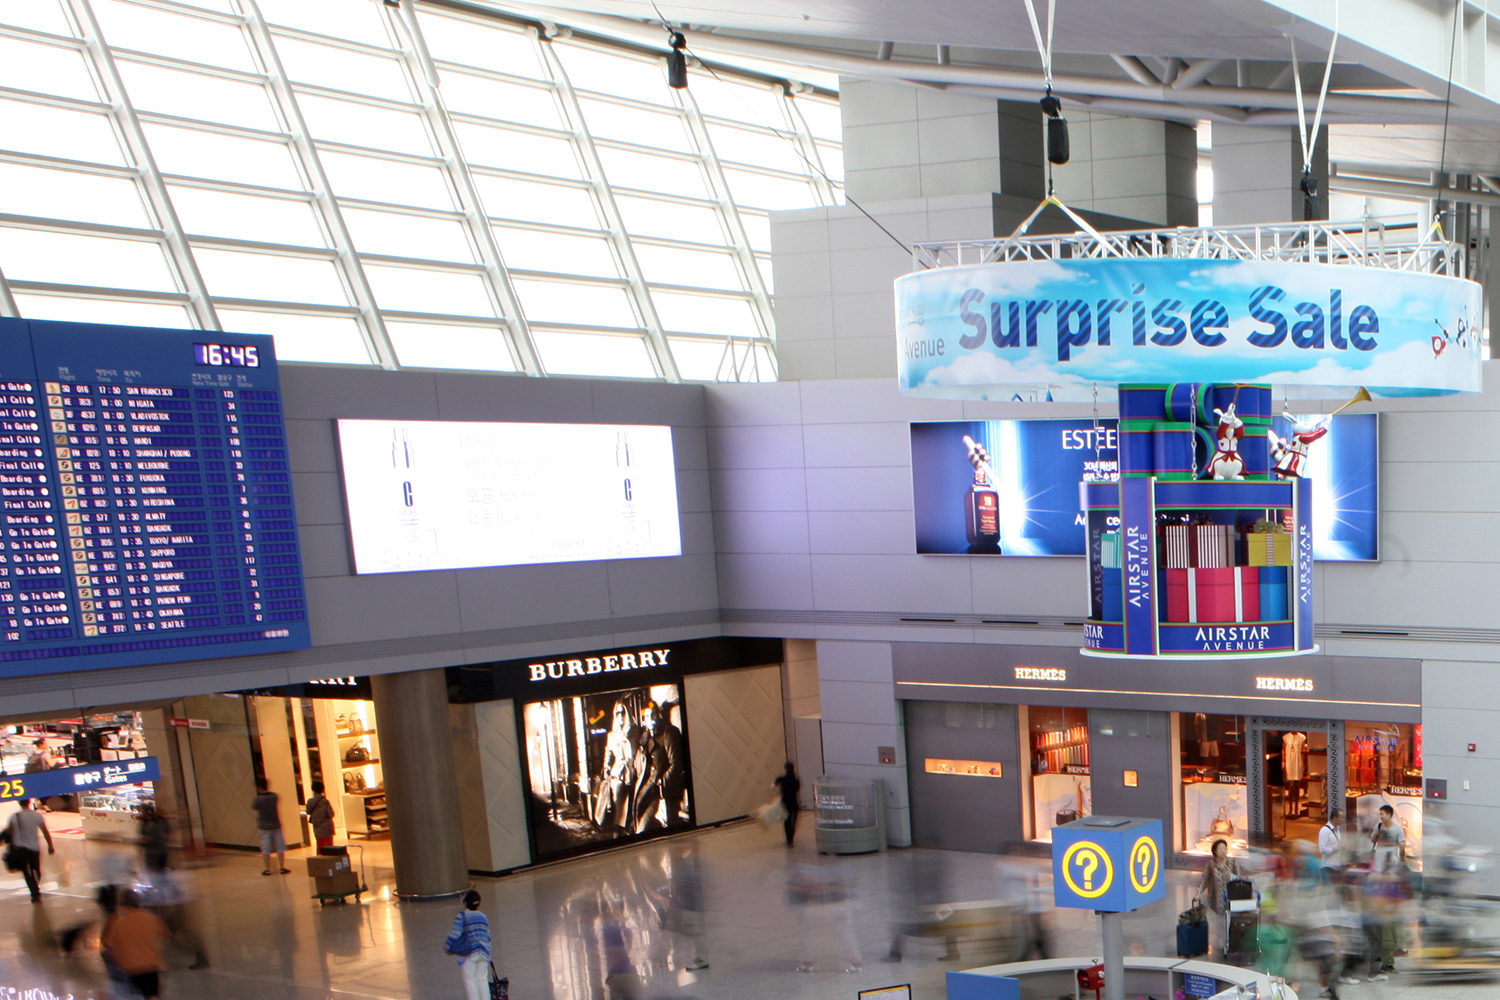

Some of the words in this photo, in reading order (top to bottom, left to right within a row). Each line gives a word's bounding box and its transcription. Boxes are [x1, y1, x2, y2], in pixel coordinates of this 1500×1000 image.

[958, 282, 1229, 361] Surprise
[1247, 284, 1380, 351] Sale
[202, 344, 259, 367] 16:45
[1127, 526, 1142, 607] AIRSTAR
[1139, 533, 1150, 600] AVENUE
[1300, 524, 1309, 603] AIRSTAR
[1195, 626, 1270, 641] AIRSTAR
[1203, 641, 1264, 650] AVENUE
[528, 648, 671, 682] BURBERRY
[1354, 735, 1398, 746] AIRSTAR
[0, 780, 25, 798] 25
[105, 774, 127, 784] Gates
